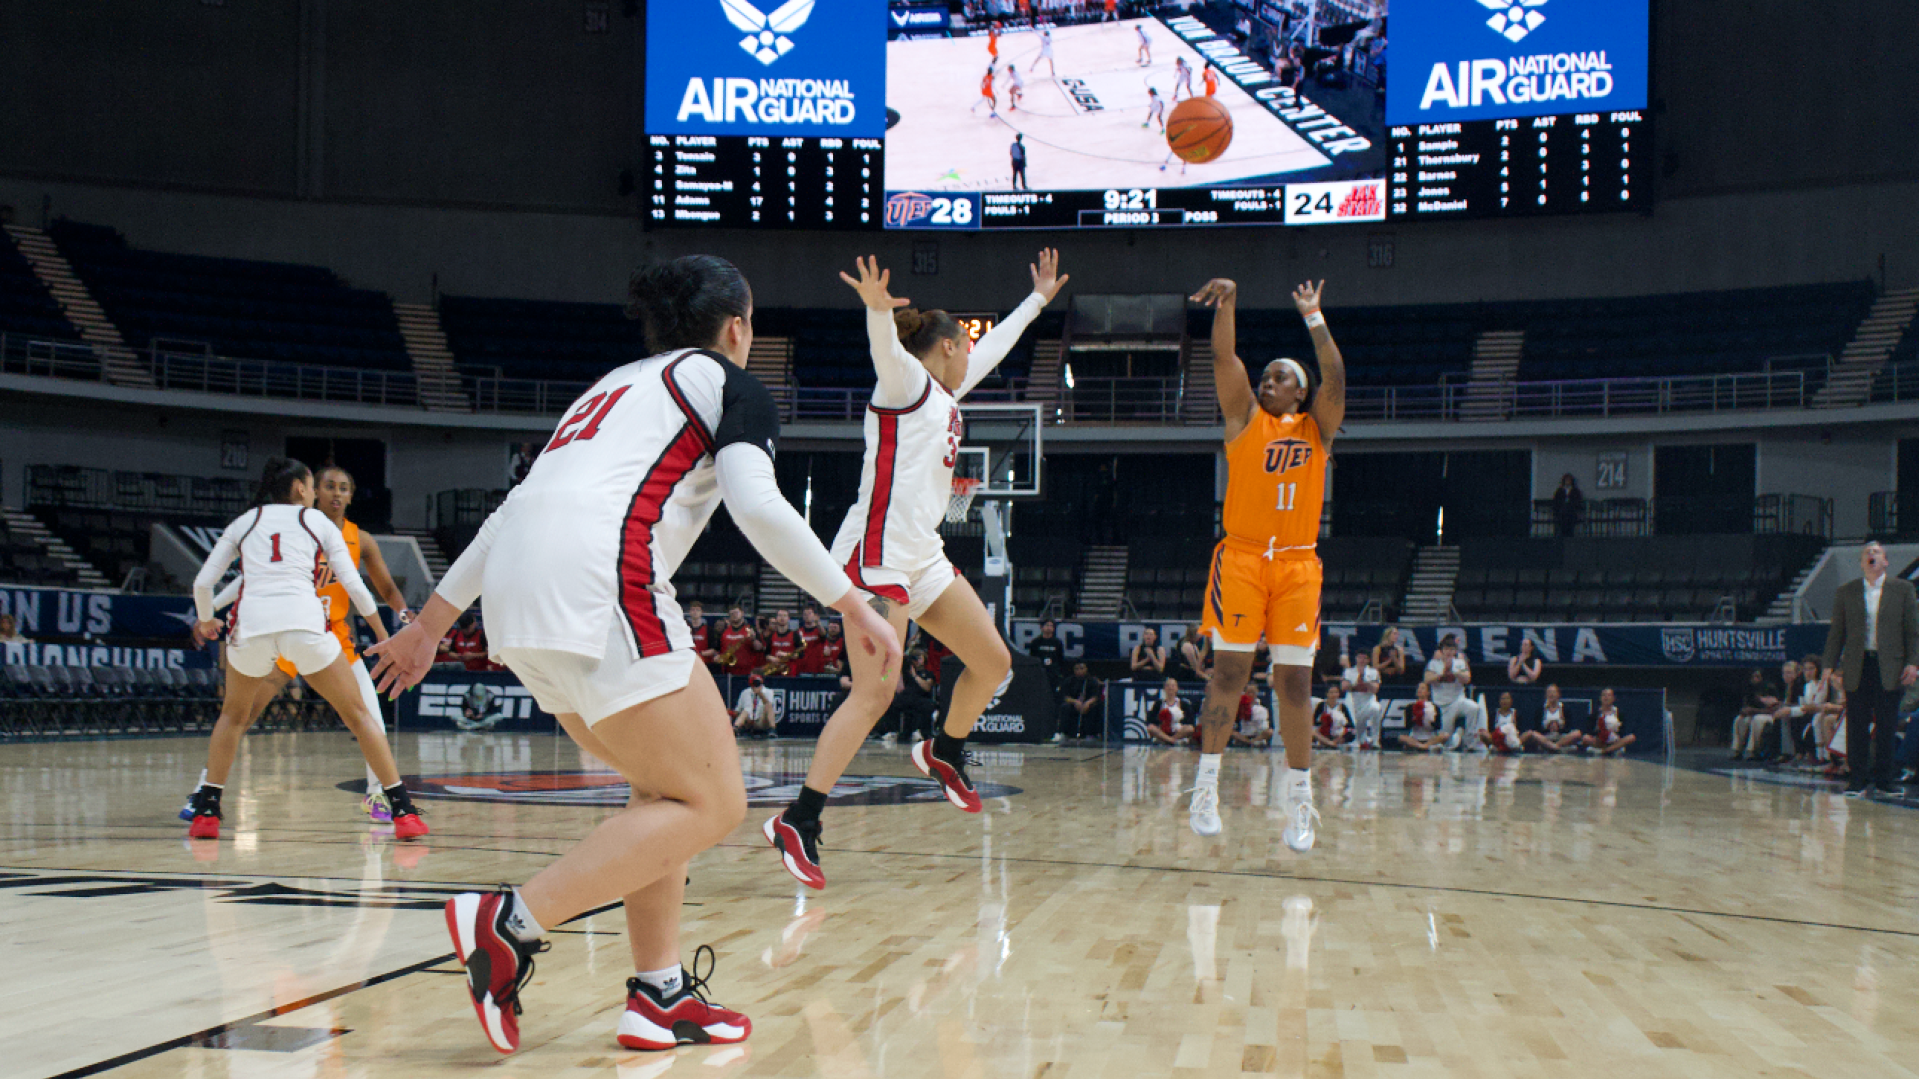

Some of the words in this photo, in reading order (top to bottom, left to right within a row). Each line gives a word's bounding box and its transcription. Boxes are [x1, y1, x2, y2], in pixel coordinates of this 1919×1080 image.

[1509, 50, 1611, 77] NATIONAL
[760, 79, 854, 98] NATIONAL
[1419, 58, 1507, 110] AIR
[1507, 71, 1613, 103] GUARD
[677, 77, 758, 122] AIR
[758, 97, 855, 124] GUARD
[1391, 126, 1412, 137] NO.
[1417, 122, 1461, 135] PLAYER
[1495, 118, 1518, 131] PTS
[1532, 115, 1557, 128] AST
[1611, 111, 1642, 122] FOUL
[650, 135, 669, 146] NO.
[675, 136, 716, 146] PLAYER
[748, 137, 769, 147] PTS
[782, 136, 804, 147] AST
[852, 138, 881, 149] FOUL
[1397, 143, 1404, 152] 1
[1581, 129, 1590, 138] 4
[655, 165, 662, 174] 4
[1500, 167, 1508, 176] 4
[752, 182, 760, 191] 4
[1211, 189, 1265, 202] TIMEOUTS
[1272, 189, 1281, 198] 4
[653, 195, 665, 204] 11
[750, 197, 763, 206] 17
[826, 197, 833, 206] 4
[887, 192, 931, 226] UTEP
[985, 194, 1038, 204] TIMEOUTS
[1045, 194, 1052, 203] 4
[985, 205, 1016, 215] FOULS
[1104, 190, 1157, 210] 9:21
[1234, 201, 1267, 211] FOULS
[1293, 191, 1333, 216] 24
[1337, 200, 1381, 217] STATE
[1501, 198, 1508, 207] 7
[930, 198, 972, 224] 28
[1104, 212, 1148, 224] PERIOD
[1184, 211, 1218, 222] POSS
[543, 384, 634, 454] 21
[1263, 437, 1313, 475] UTEP
[1598, 462, 1626, 487] 214
[1276, 481, 1297, 511] 11
[270, 532, 283, 563] 1
[57, 592, 112, 634] US
[1014, 622, 1084, 658] BC
[1697, 628, 1786, 651] HUNTSVILLE
[986, 721, 1025, 733] GUARD
